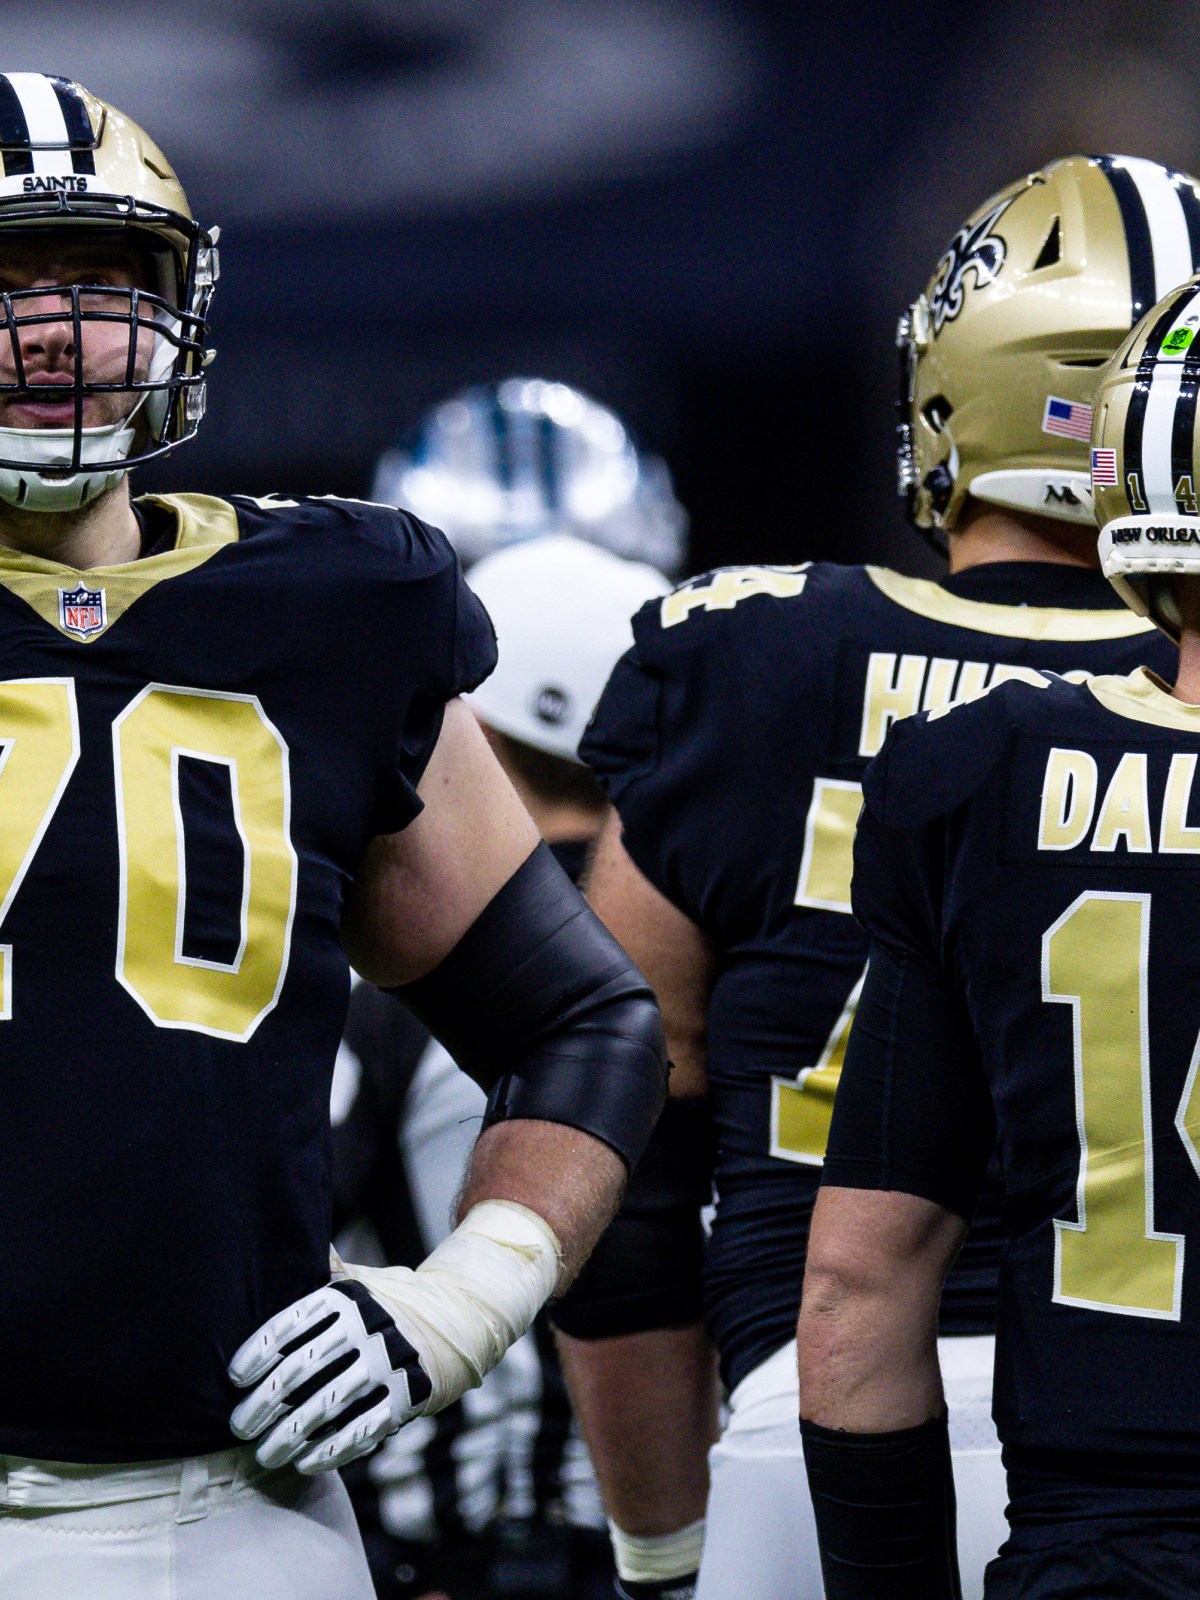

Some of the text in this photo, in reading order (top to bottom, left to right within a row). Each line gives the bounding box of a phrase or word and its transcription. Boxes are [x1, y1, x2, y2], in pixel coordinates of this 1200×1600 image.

[22, 175, 88, 192] SAINTS
[1110, 526, 1200, 544] NEW ORLEA
[67, 607, 100, 629] NFL
[1041, 889, 1200, 1322] 1
